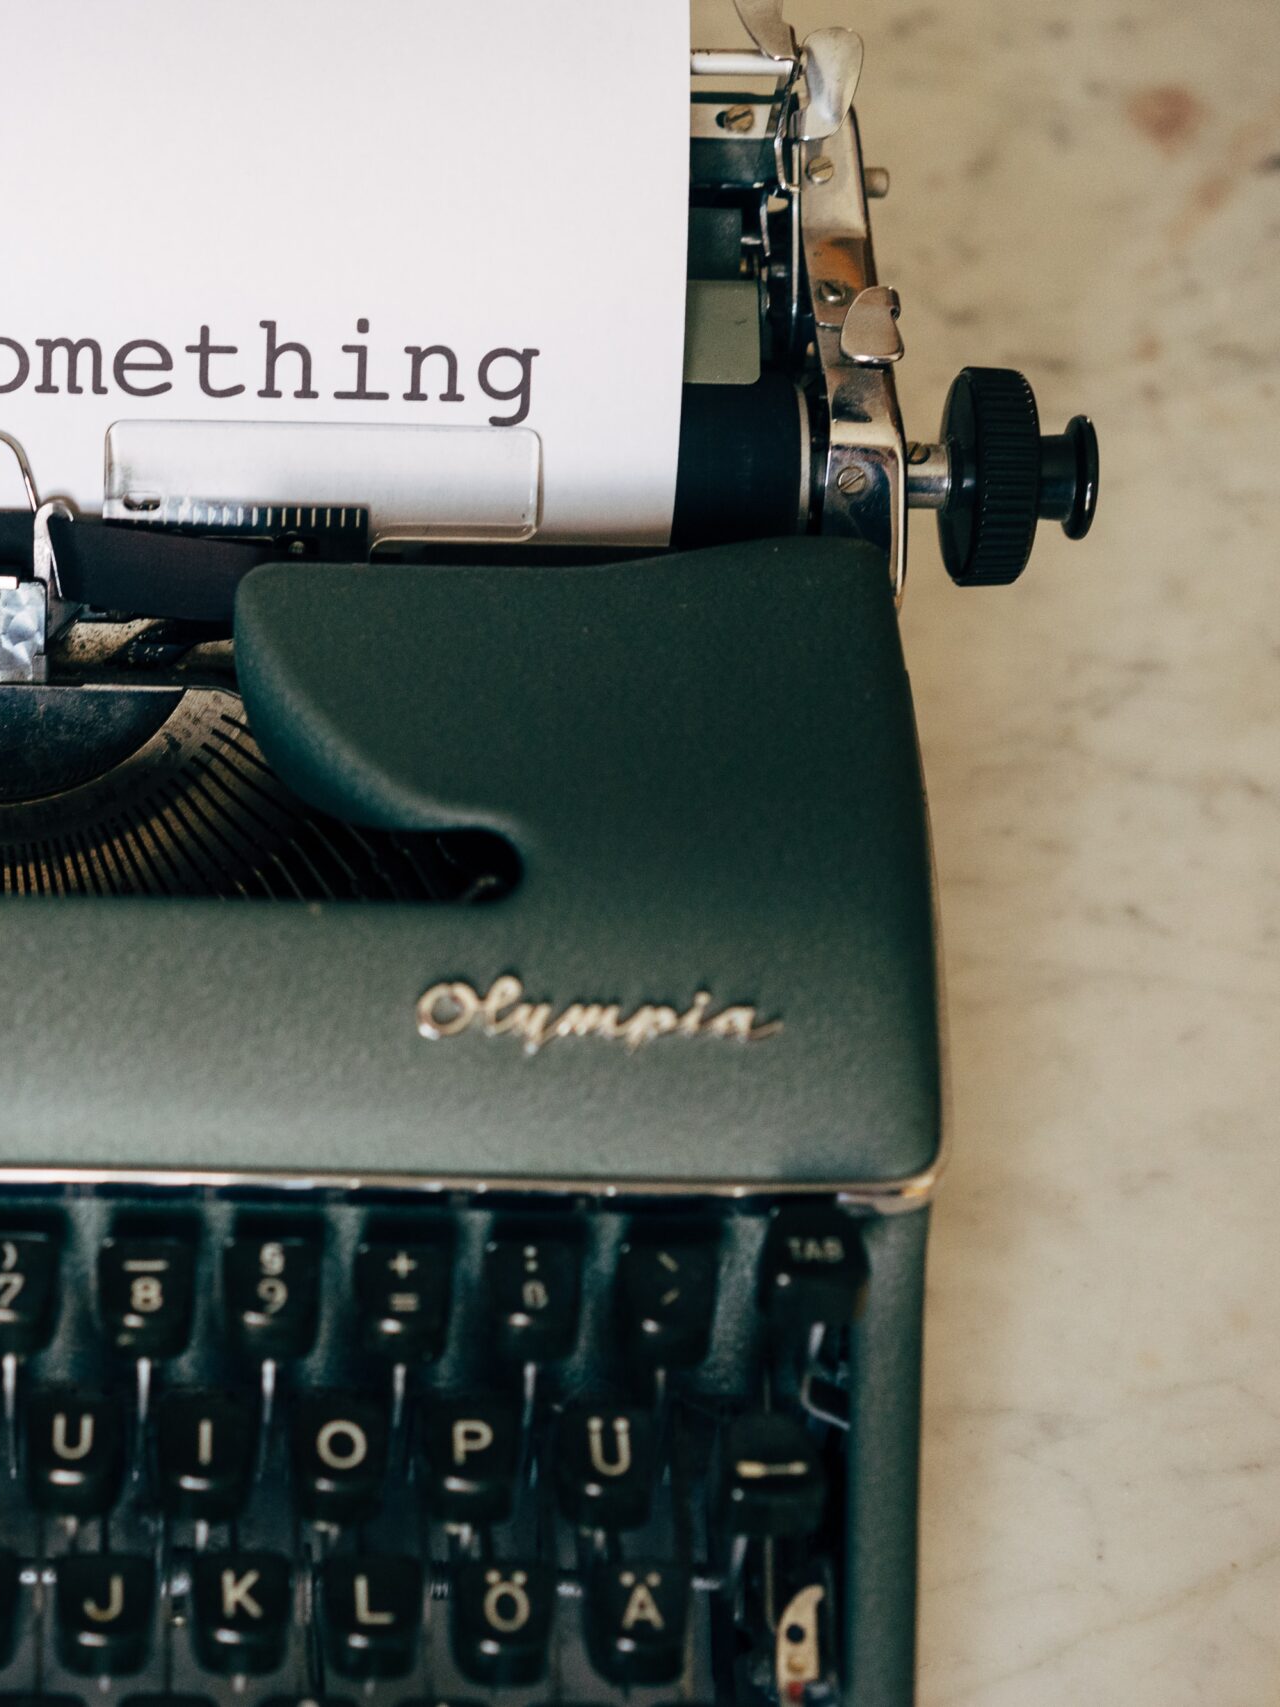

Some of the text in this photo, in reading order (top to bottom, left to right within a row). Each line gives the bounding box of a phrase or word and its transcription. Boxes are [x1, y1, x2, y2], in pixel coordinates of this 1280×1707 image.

[417, 974, 784, 1056] Olympia
[392, 1254, 414, 1275] +
[790, 1238, 842, 1260] TAB
[132, 1278, 162, 1311] 8
[257, 1279, 287, 1314] 9
[54, 1415, 93, 1458] U
[200, 1420, 211, 1463] I
[318, 1421, 366, 1468] O
[453, 1421, 492, 1462] P
[589, 1417, 630, 1475] Ü
[84, 1576, 122, 1620] J
[223, 1571, 260, 1616] K
[355, 1576, 391, 1623] L
[485, 1570, 529, 1630] Ö
[621, 1572, 662, 1626] Ä
